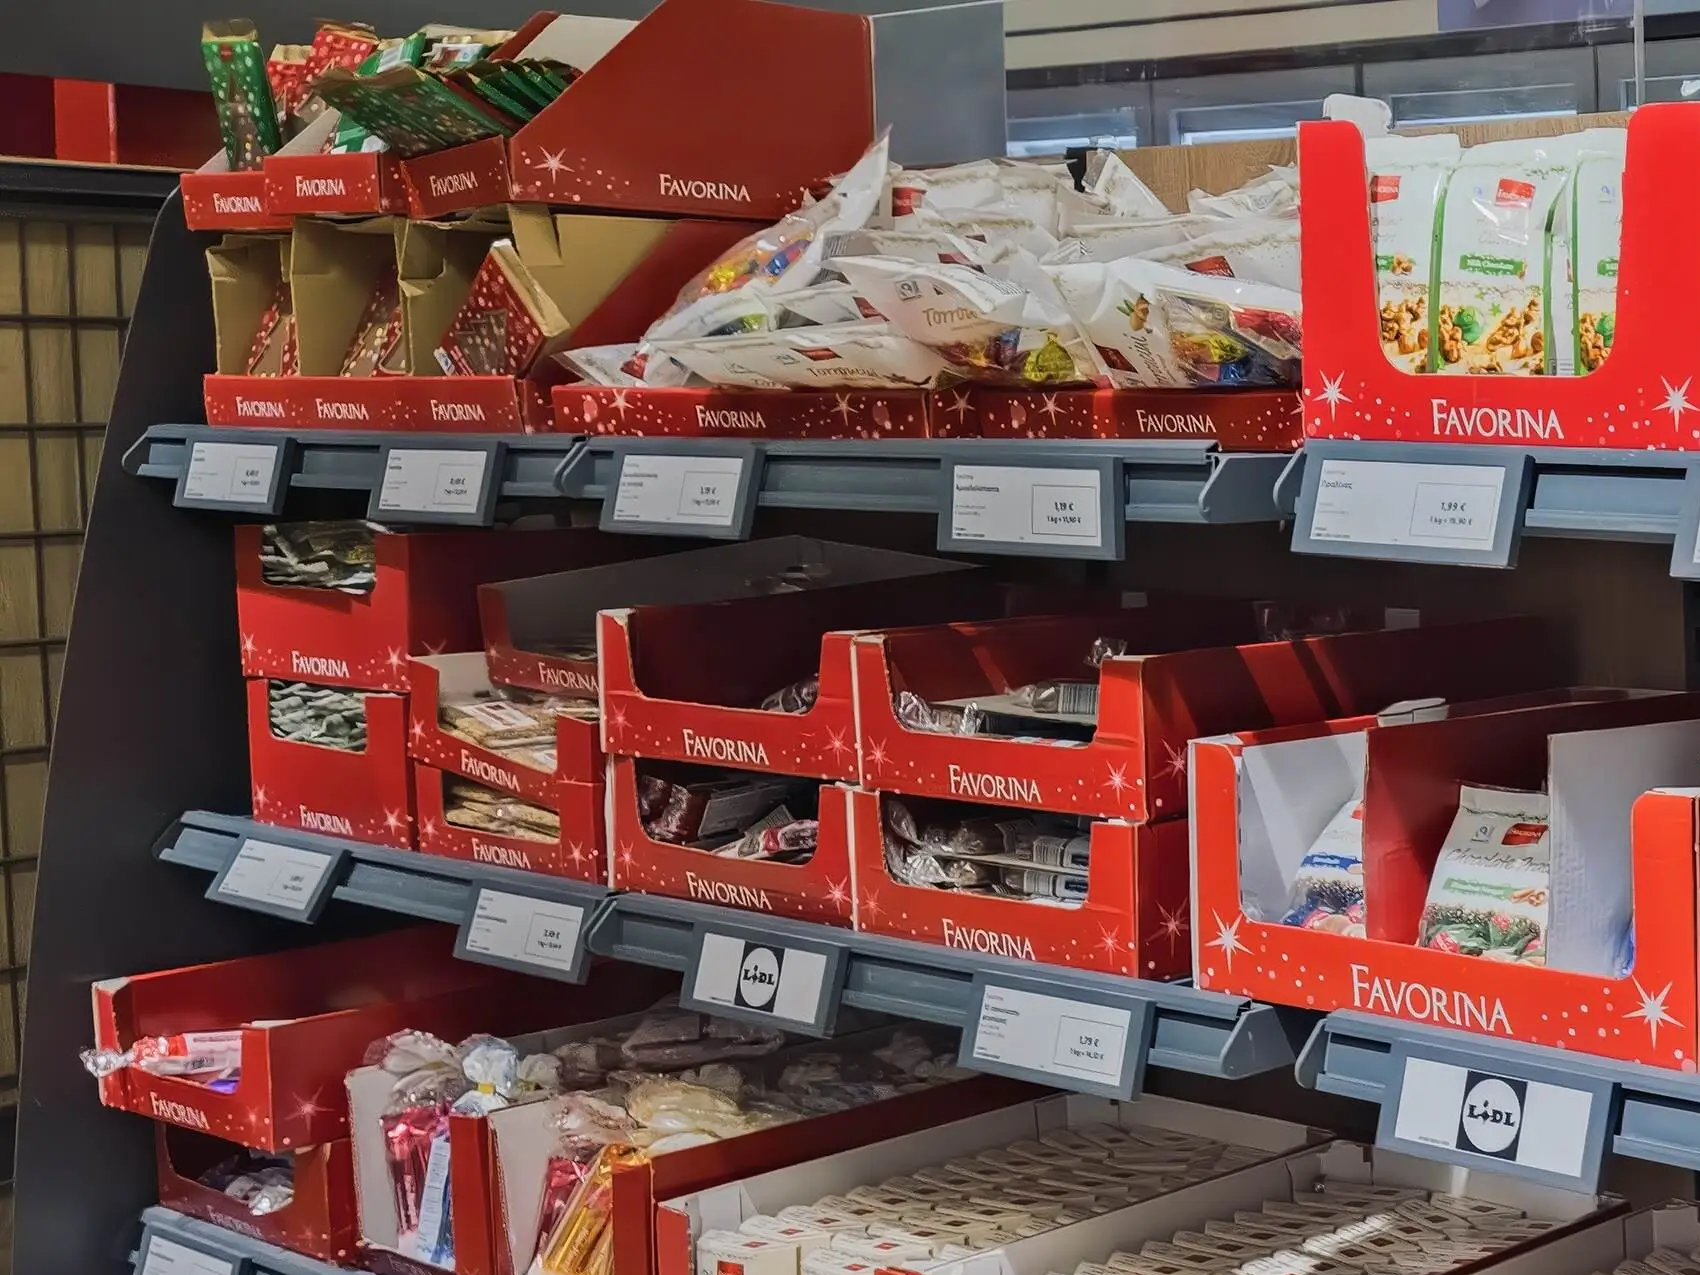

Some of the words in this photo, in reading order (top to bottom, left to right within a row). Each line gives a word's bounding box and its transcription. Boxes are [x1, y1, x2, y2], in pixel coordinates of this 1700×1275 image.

[659, 173, 752, 203] FAVORINA
[1136, 408, 1216, 435] FAVORINA
[1430, 399, 1564, 441] FAVORINA
[683, 729, 770, 766] FAVORINA
[948, 764, 1042, 804] FAVORINA
[683, 872, 772, 909] FAVORINA
[942, 917, 1036, 960] FAVORINA
[1351, 964, 1514, 1036] FAVORINA
